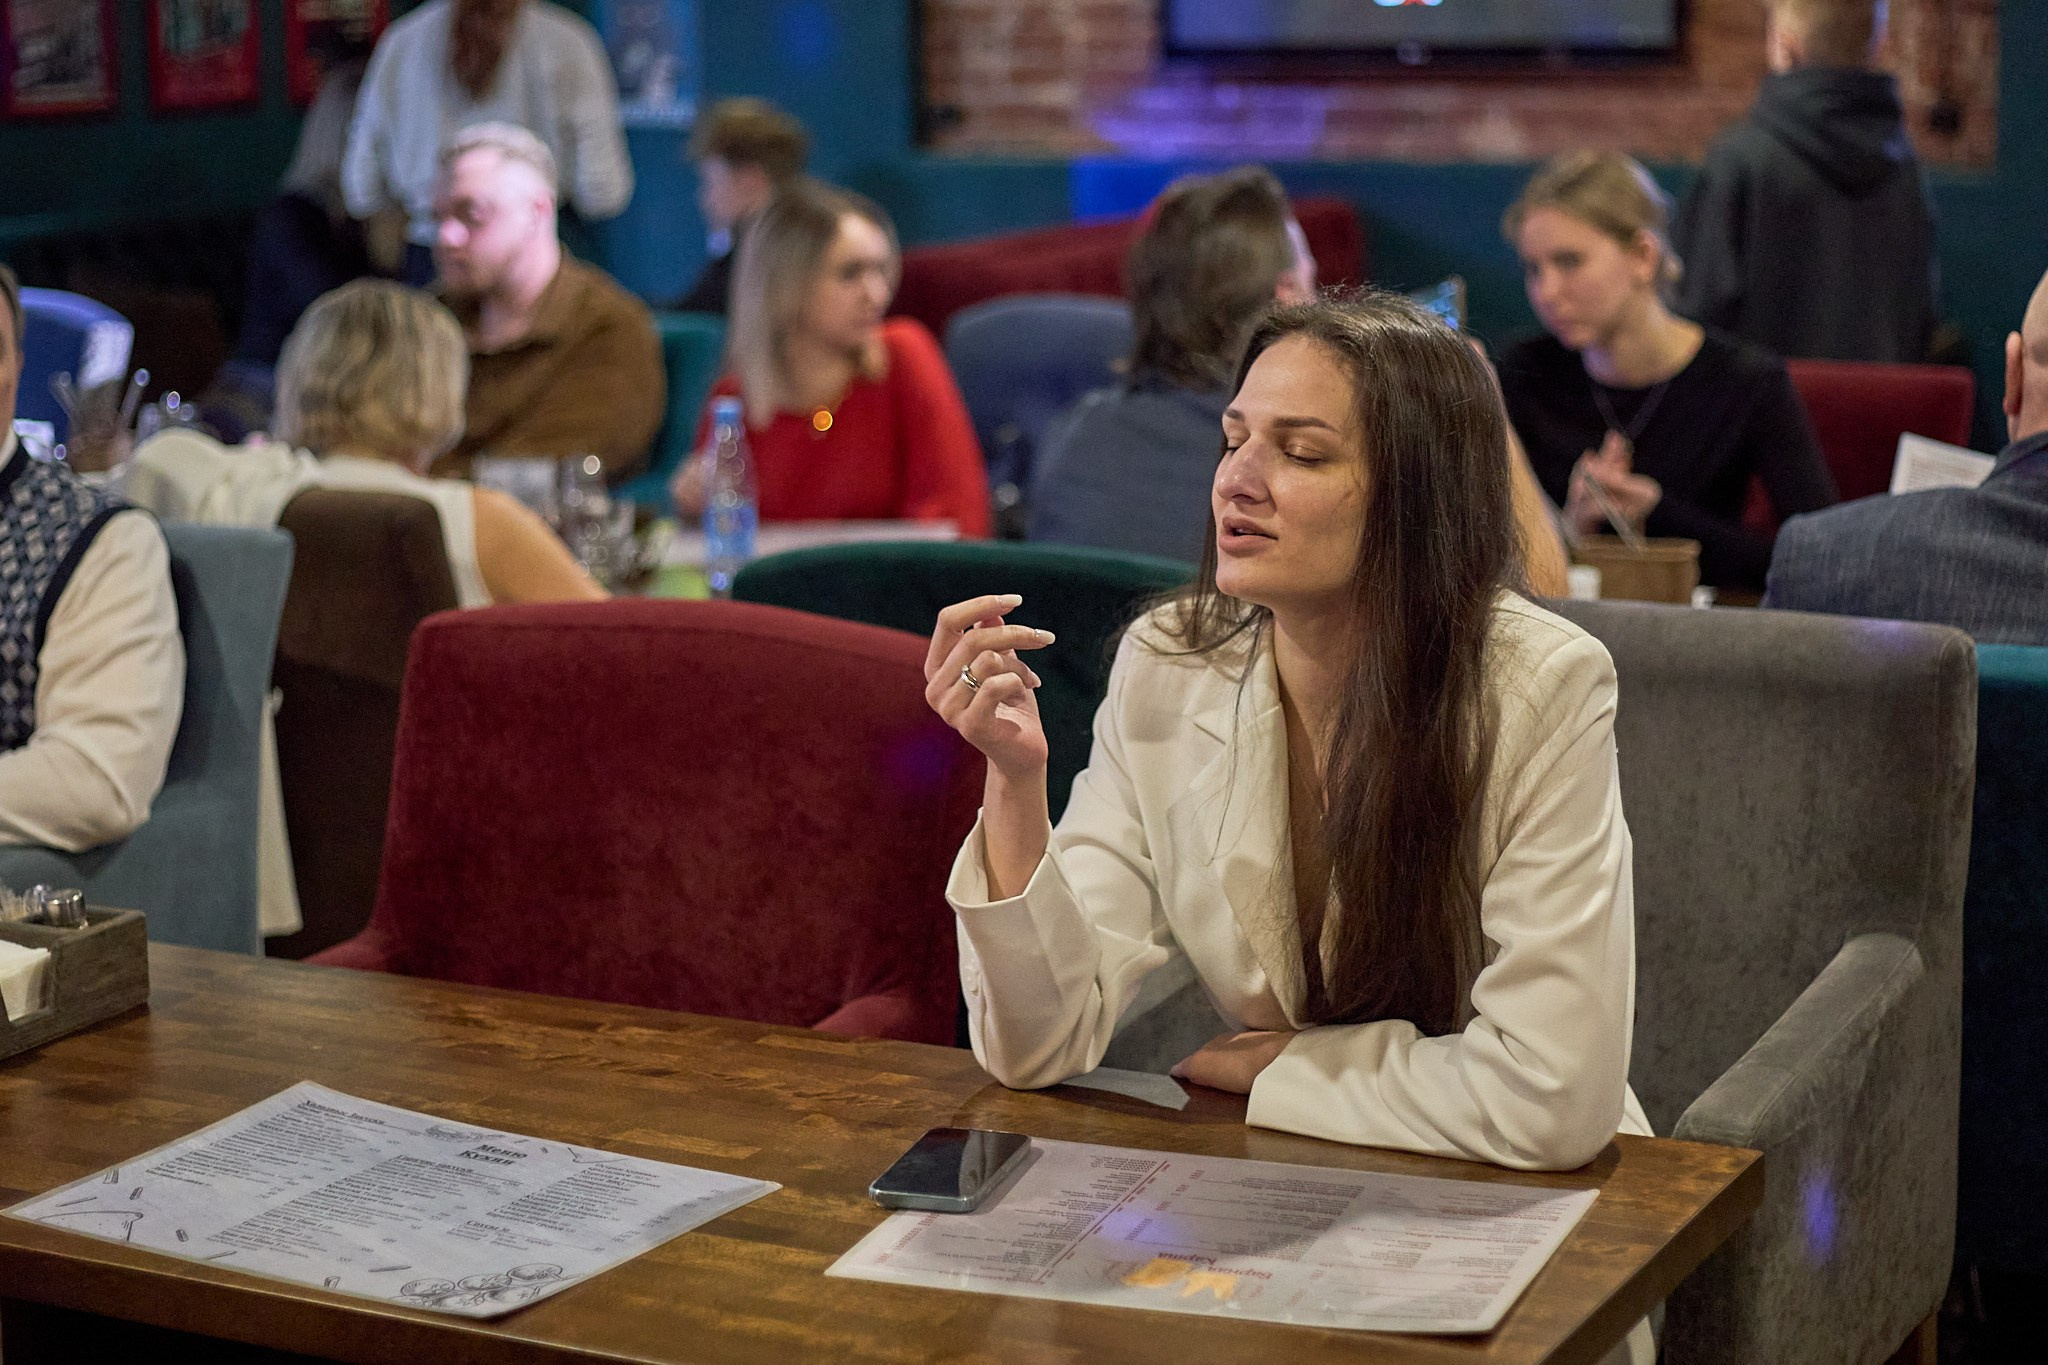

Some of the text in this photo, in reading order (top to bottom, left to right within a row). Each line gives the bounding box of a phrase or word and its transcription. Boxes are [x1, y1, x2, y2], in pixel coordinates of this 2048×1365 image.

[458, 1149, 517, 1166] Кухни
[476, 1143, 528, 1160] Меню
[1158, 1251, 1217, 1265] Карта
